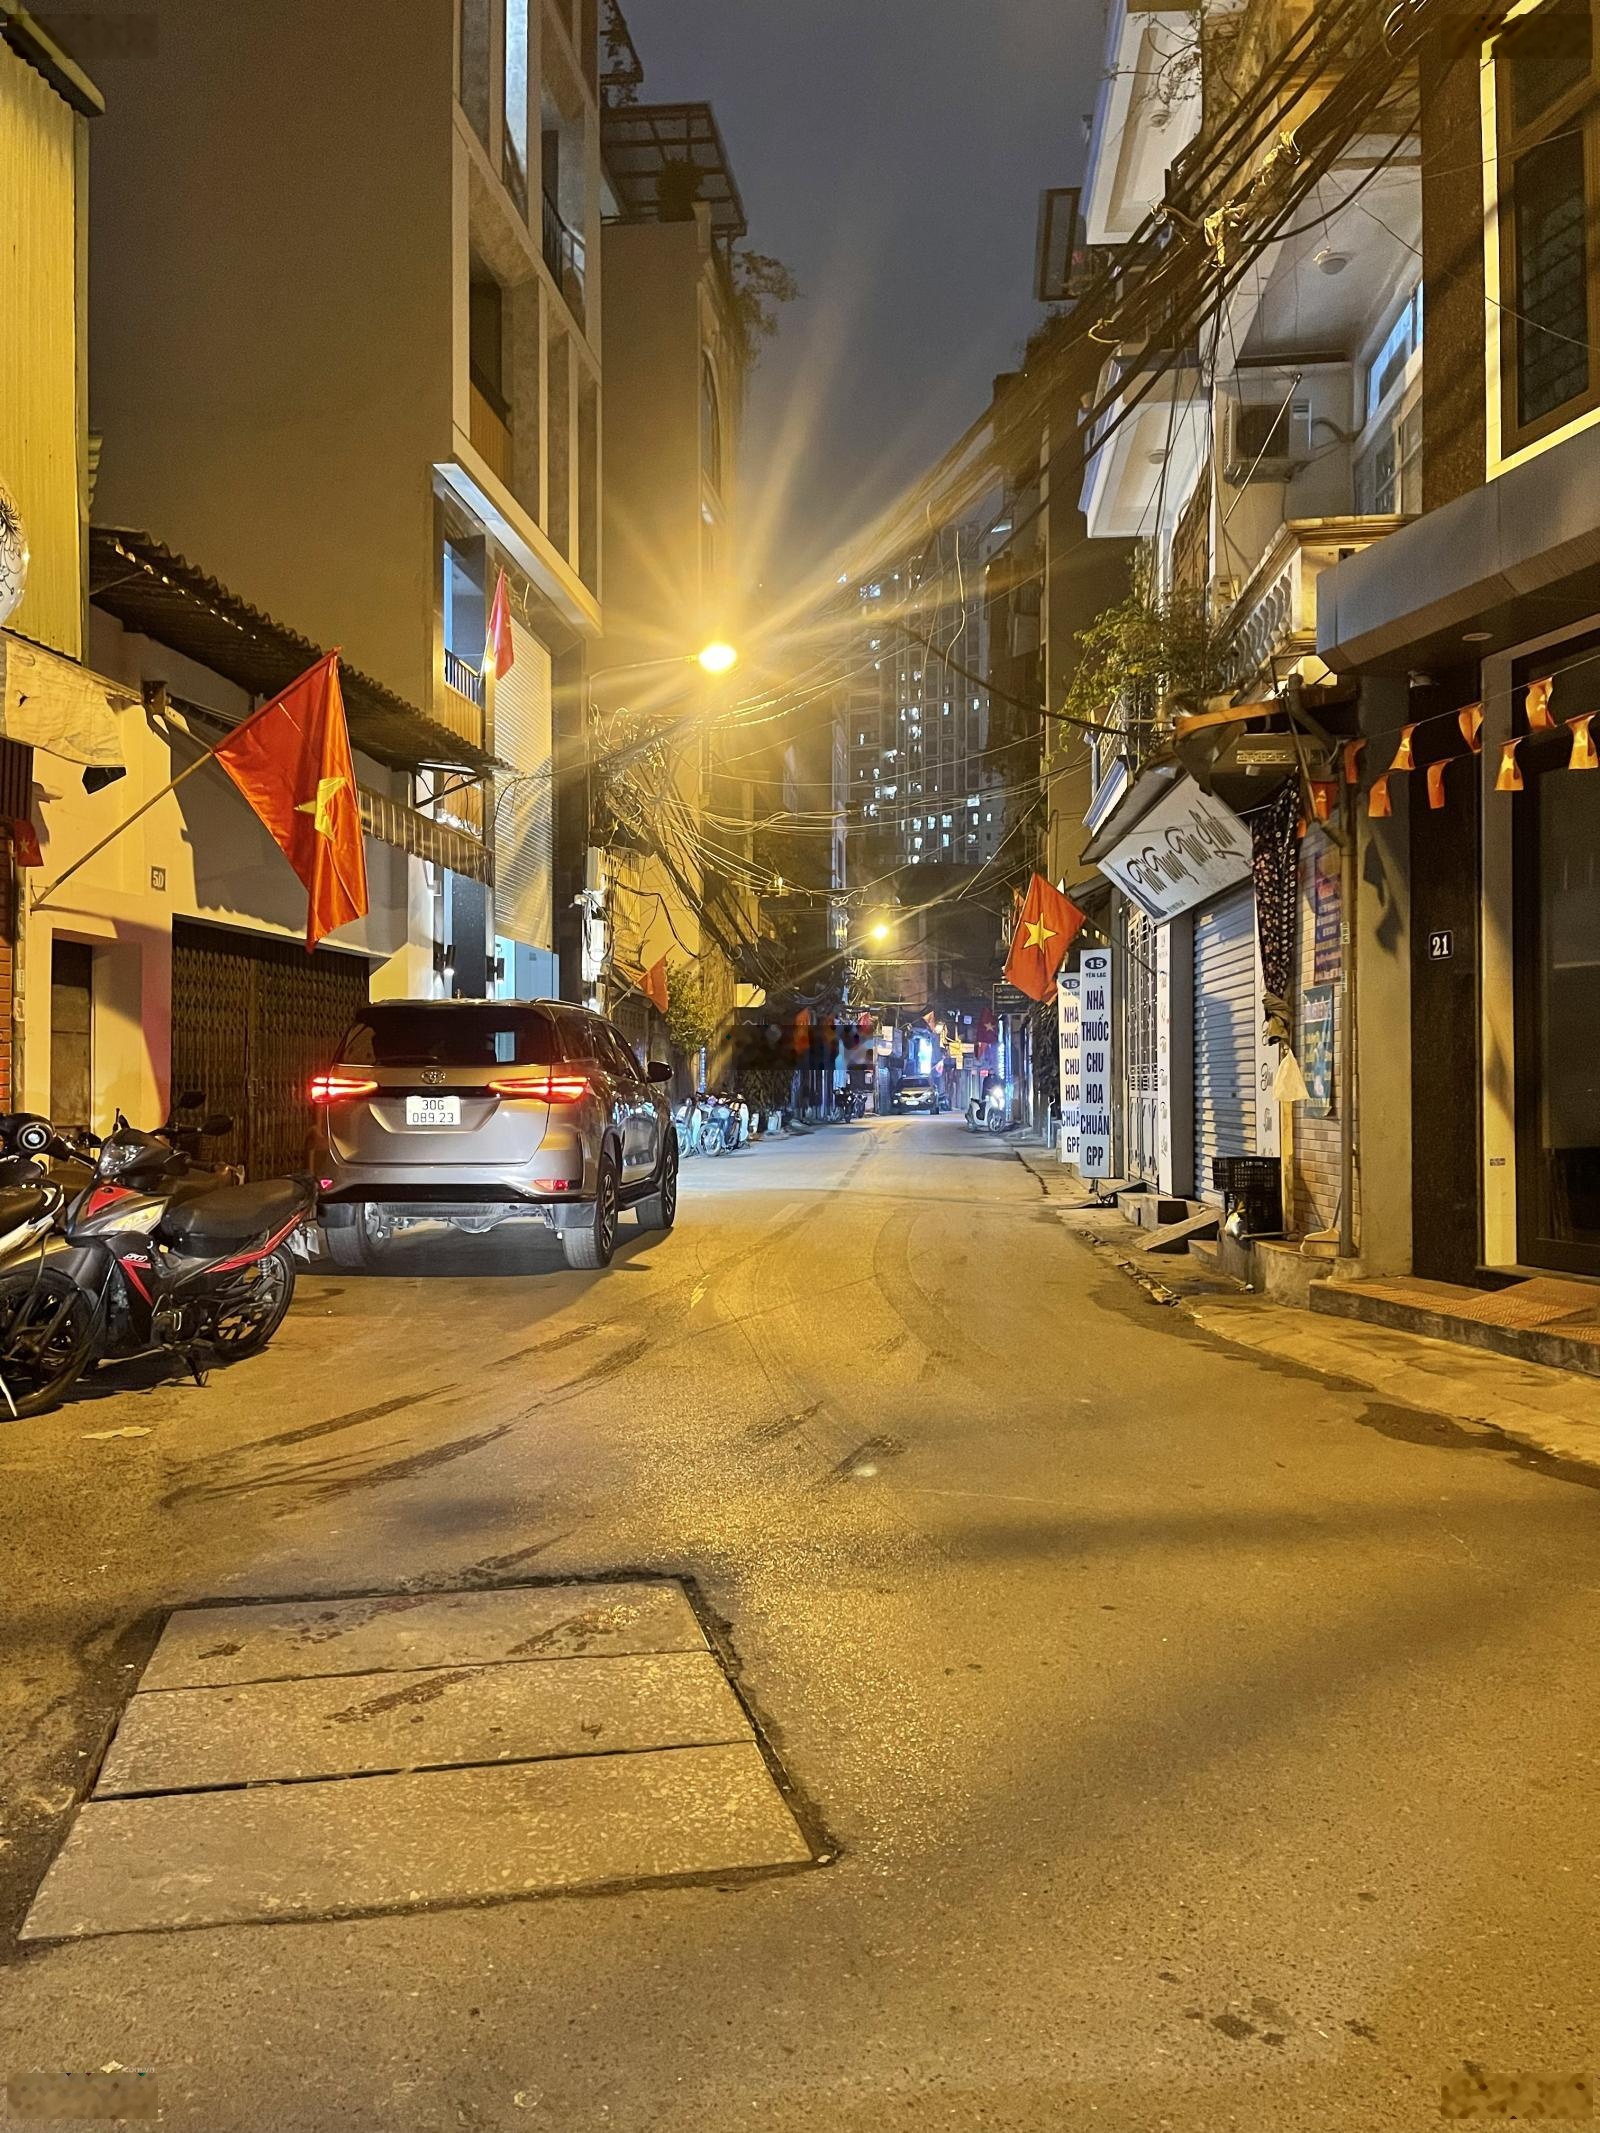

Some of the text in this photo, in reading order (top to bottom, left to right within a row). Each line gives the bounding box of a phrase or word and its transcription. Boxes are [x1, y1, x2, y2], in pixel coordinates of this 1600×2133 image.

[1432, 935, 1449, 956] 21
[1088, 959, 1104, 968] 15
[1086, 985, 1105, 1010] NHÀ
[1064, 1003, 1079, 1023] NHÀ
[1060, 1026, 1079, 1049] THUỐ
[1081, 1013, 1109, 1041] THUỐC
[1064, 1059, 1080, 1075] CHU
[1086, 1052, 1104, 1073] CHU
[1065, 1084, 1080, 1101] HOA
[1086, 1083, 1104, 1104] HOA
[422, 1099, 445, 1110] 30G
[1061, 1106, 1080, 1127] CHUẨ
[1080, 1106, 1110, 1135] CHUẨN
[1086, 1145, 1104, 1166] GPP
